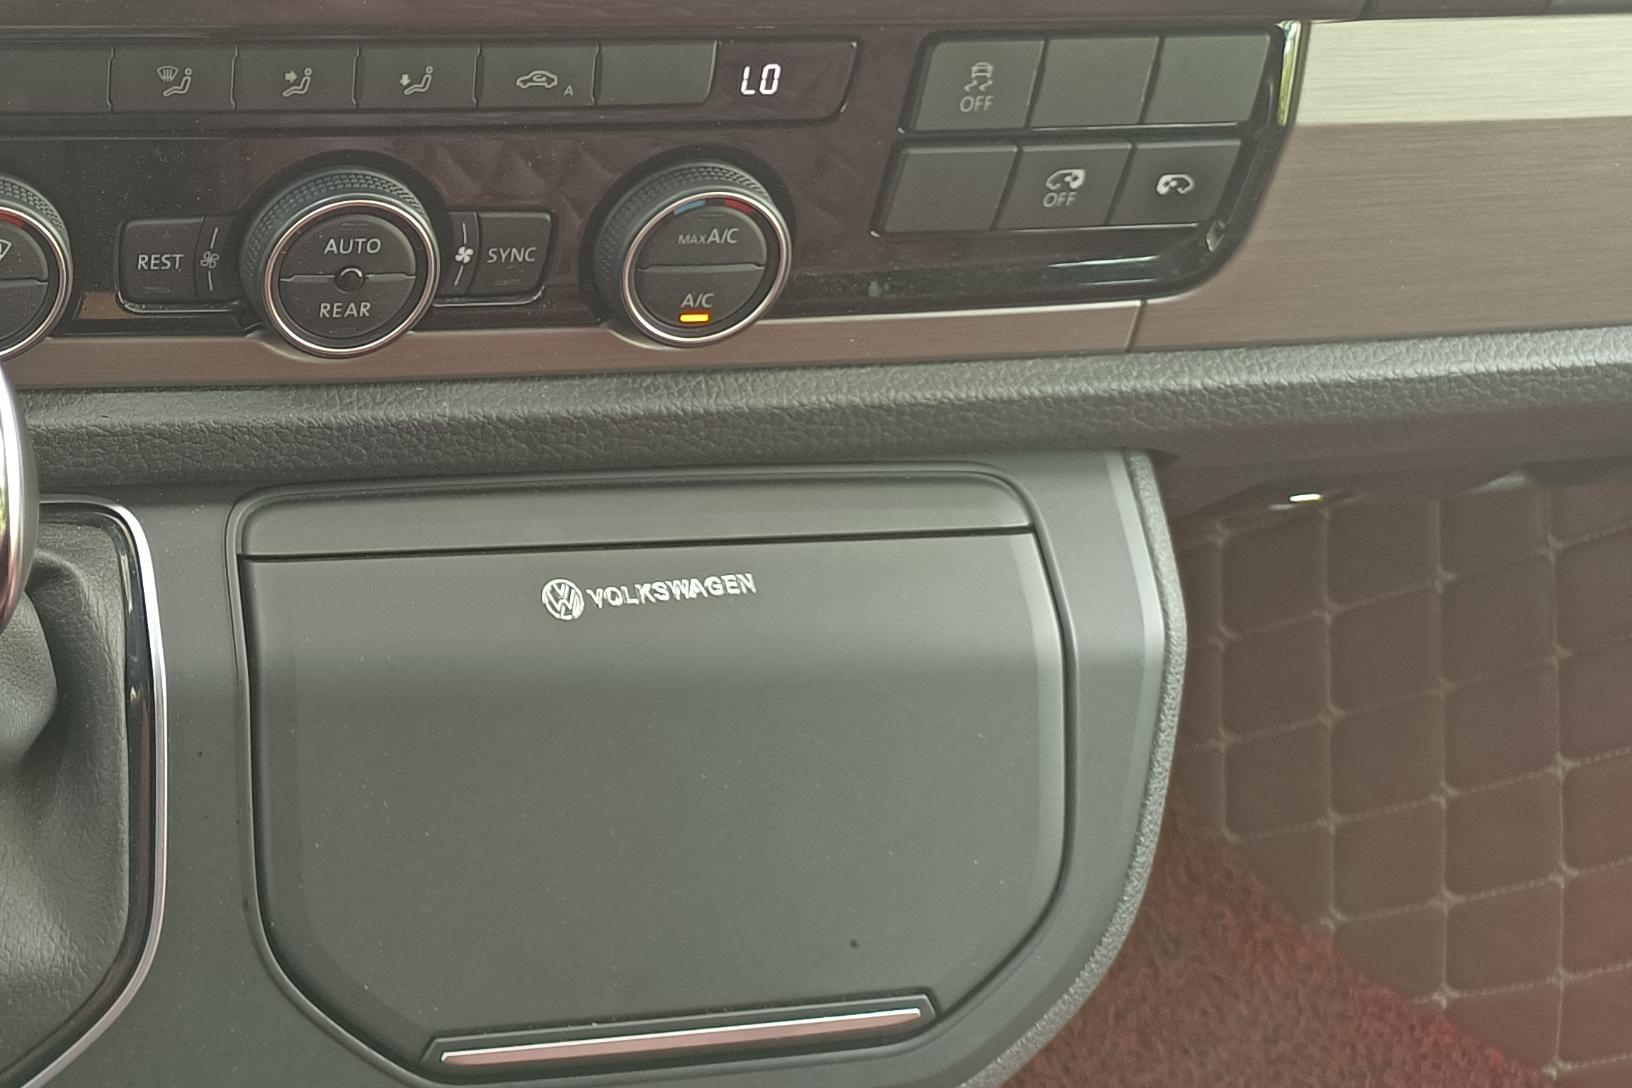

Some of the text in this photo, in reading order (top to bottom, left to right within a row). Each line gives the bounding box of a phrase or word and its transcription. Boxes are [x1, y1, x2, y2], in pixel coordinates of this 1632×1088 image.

[959, 95, 993, 114] OFF
[1042, 192, 1078, 209] OFF
[324, 237, 382, 255] AUTO
[137, 253, 184, 271] REST
[487, 246, 537, 265] SYNC
[680, 291, 714, 309] A/C
[318, 301, 371, 319] REAR
[586, 573, 757, 609] VOLKSWAGEN
